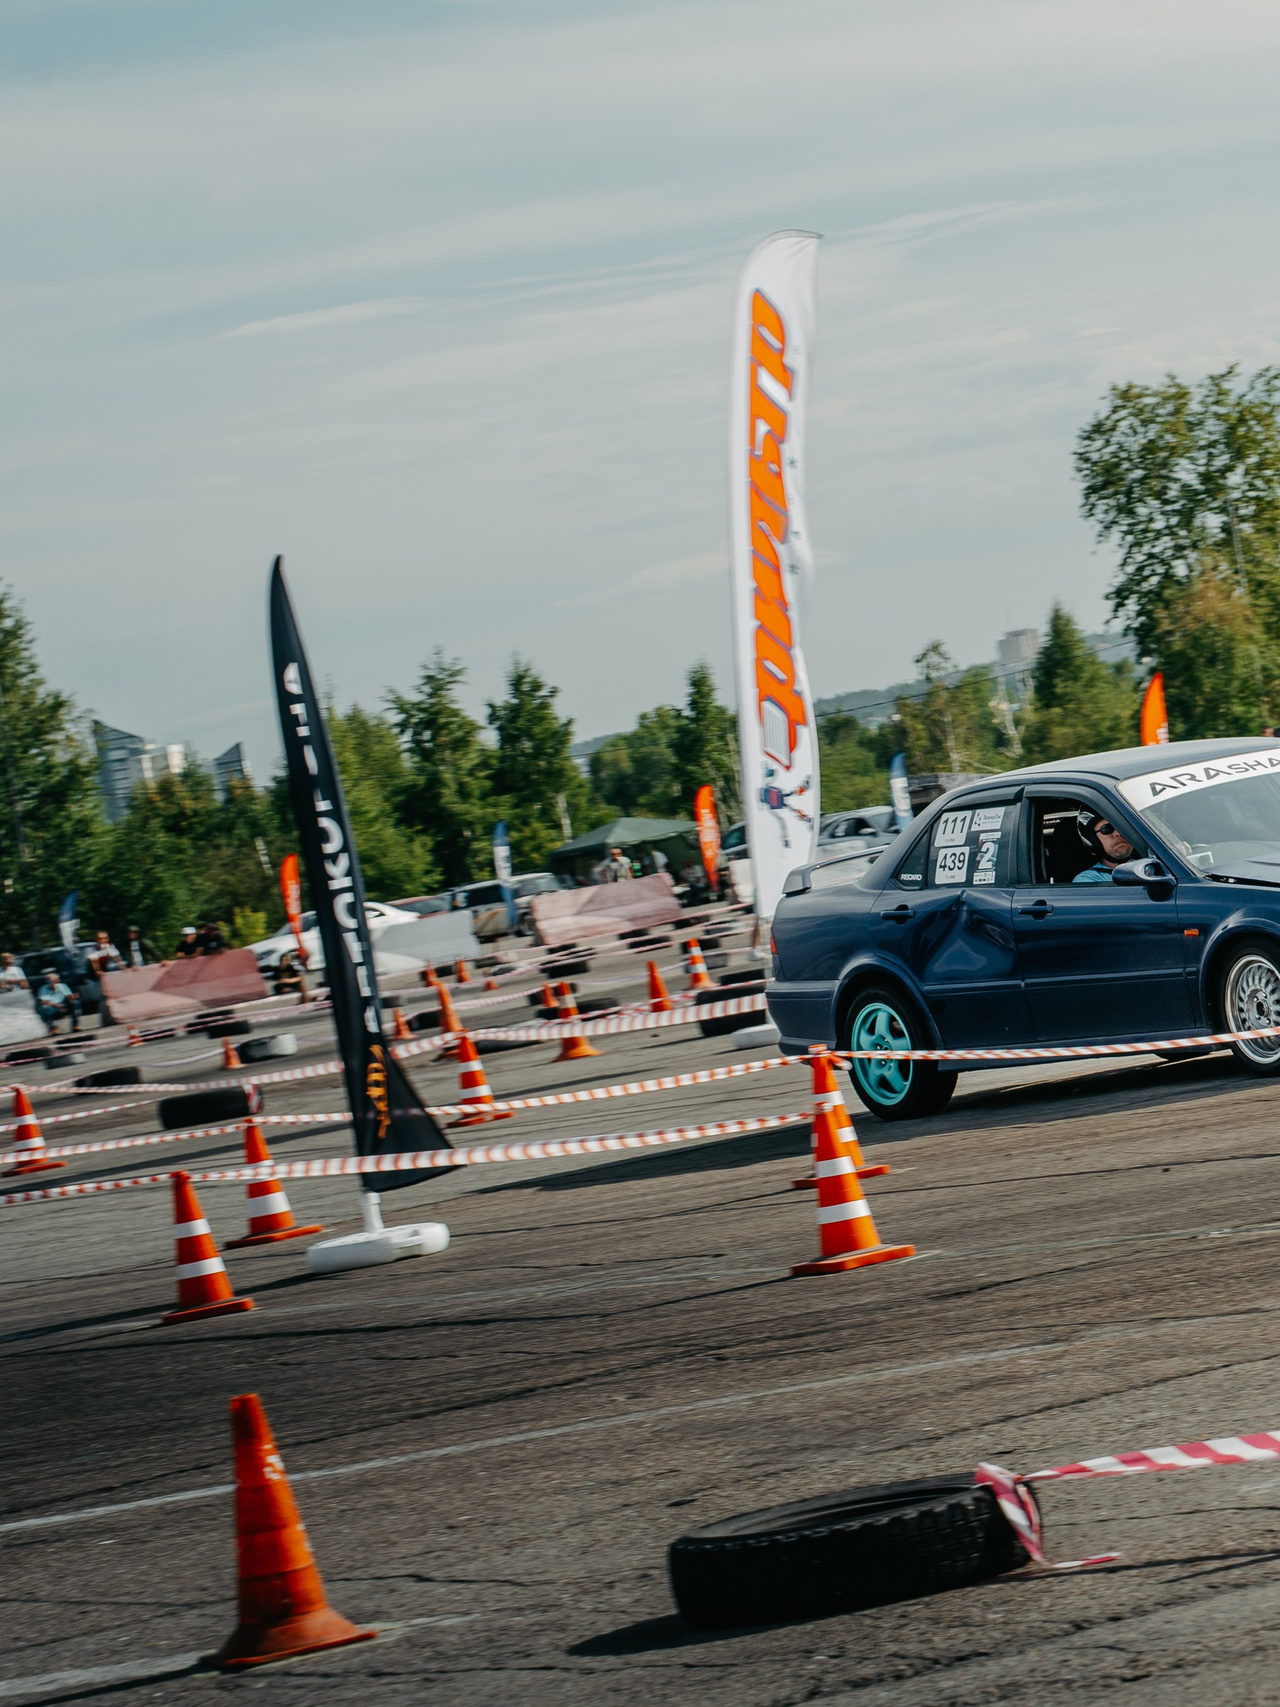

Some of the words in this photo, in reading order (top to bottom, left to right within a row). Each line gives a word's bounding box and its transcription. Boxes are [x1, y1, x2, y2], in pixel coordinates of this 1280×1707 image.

[941, 815, 967, 835] 111
[938, 851, 966, 872] 439
[978, 842, 994, 869] 2
